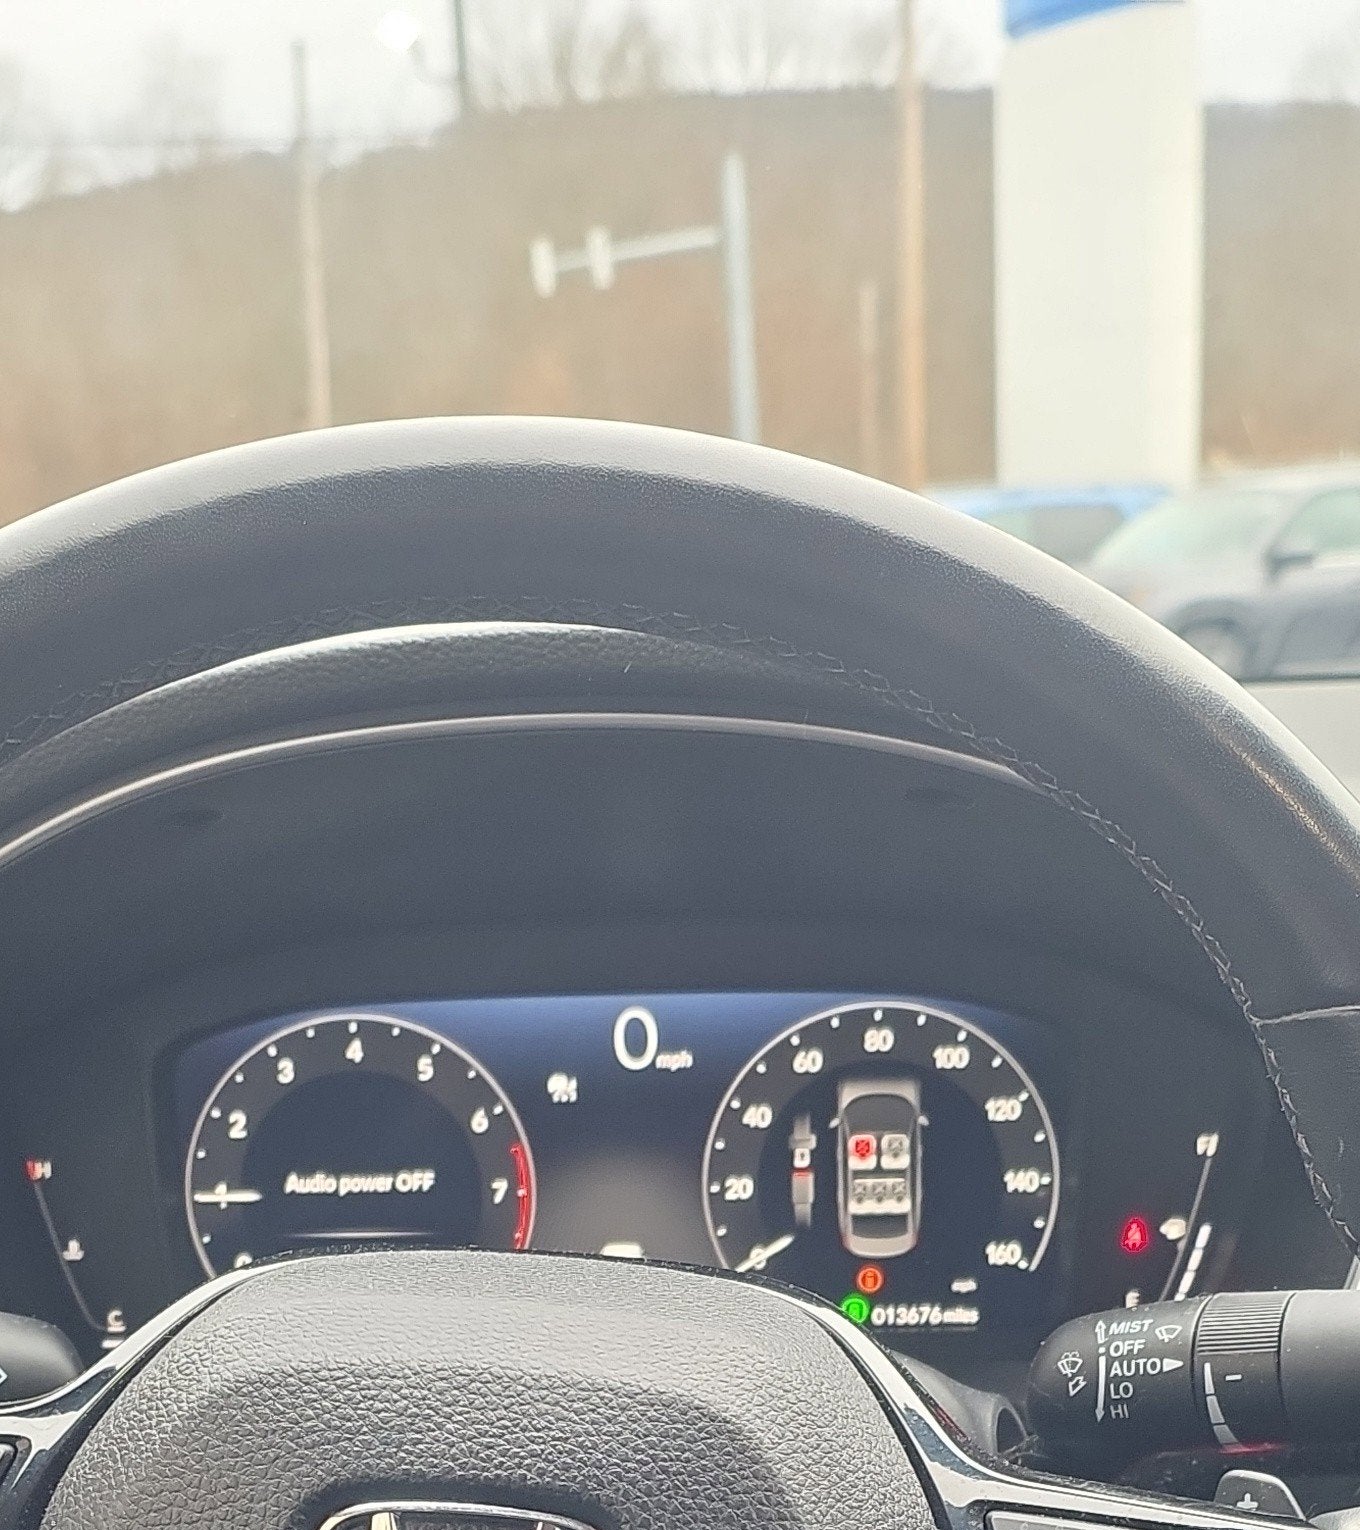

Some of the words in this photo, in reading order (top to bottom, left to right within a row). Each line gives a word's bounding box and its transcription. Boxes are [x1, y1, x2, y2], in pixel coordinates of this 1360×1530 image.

[614, 1005, 658, 1070] 0
[864, 1028, 894, 1052] 80
[343, 1037, 364, 1064] 4
[792, 1050, 823, 1073] 60
[933, 1046, 970, 1069] 100
[277, 1057, 294, 1084] 3
[417, 1053, 434, 1082] 5
[470, 1106, 489, 1134] 6
[742, 1104, 772, 1128] 40
[985, 1098, 1022, 1122] 120
[228, 1110, 247, 1139] 2
[284, 1172, 337, 1194] Audio
[339, 1176, 392, 1197] power
[395, 1170, 435, 1192] OFF
[491, 1178, 508, 1205] 7
[724, 1176, 754, 1201] 20
[1004, 1169, 1040, 1193] 140
[985, 1241, 1022, 1266] 160
[870, 1304, 942, 1326] 013676
[1109, 1318, 1153, 1335] MIST
[1110, 1339, 1145, 1357] OFF
[1110, 1358, 1161, 1377] AUTO
[1110, 1381, 1133, 1399] LO
[1110, 1403, 1129, 1419] HI
